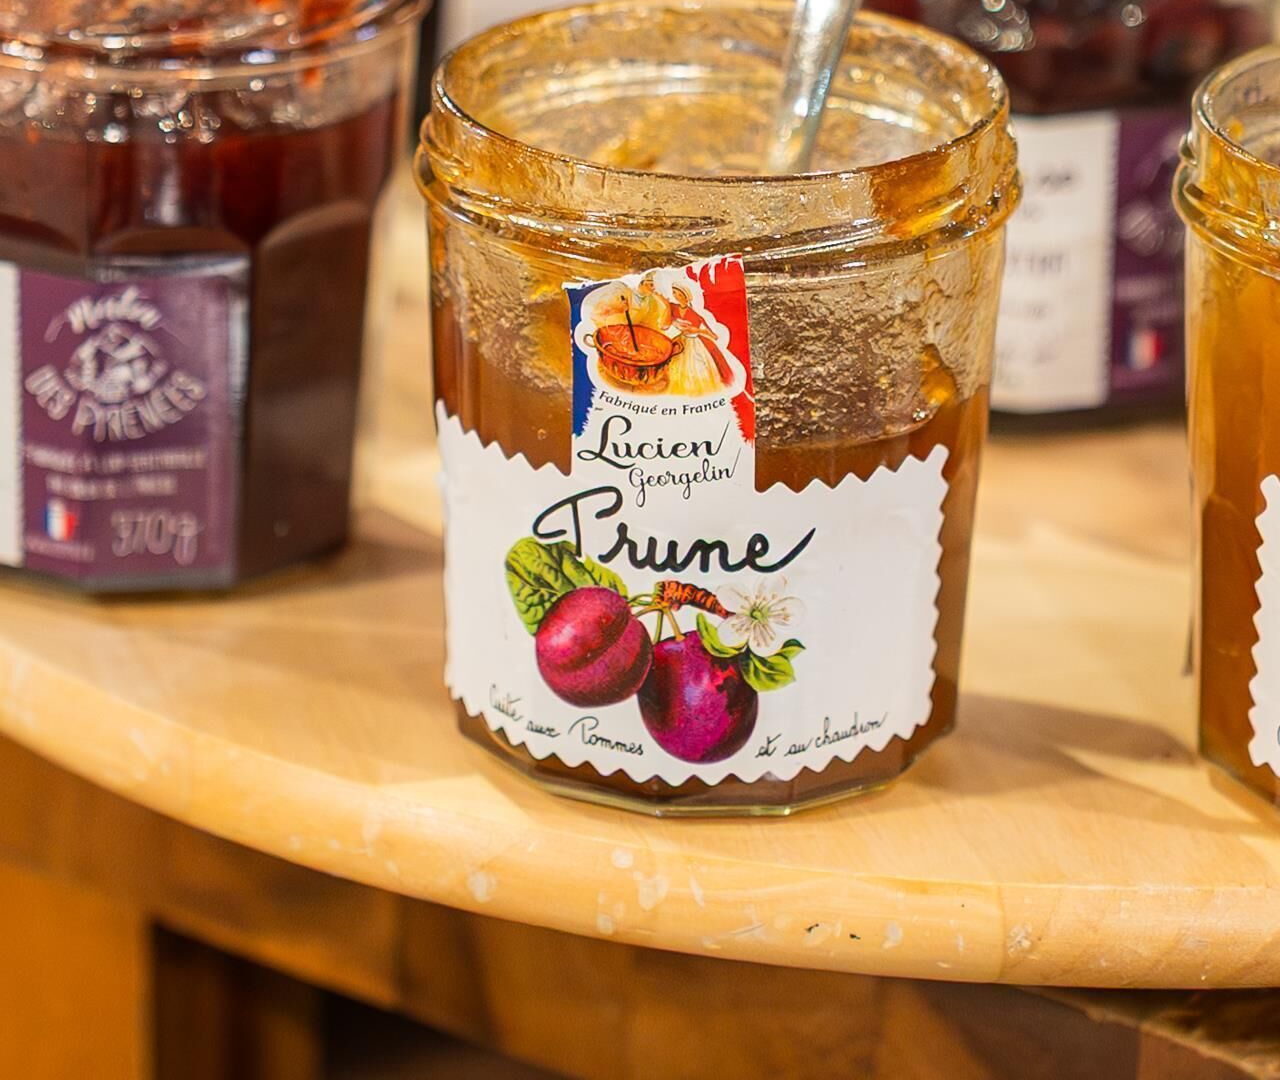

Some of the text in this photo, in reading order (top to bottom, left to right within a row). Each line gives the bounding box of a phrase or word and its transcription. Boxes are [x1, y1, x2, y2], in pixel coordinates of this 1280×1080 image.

[598, 390, 726, 416] Fabriqué en France
[577, 415, 731, 470] Lucien
[628, 447, 742, 508] Georgelin
[532, 485, 817, 575] Prune
[489, 683, 524, 722] Cuite
[526, 721, 561, 738] aux
[567, 715, 645, 756] Pommes
[754, 733, 783, 759] et
[783, 738, 815, 757] au
